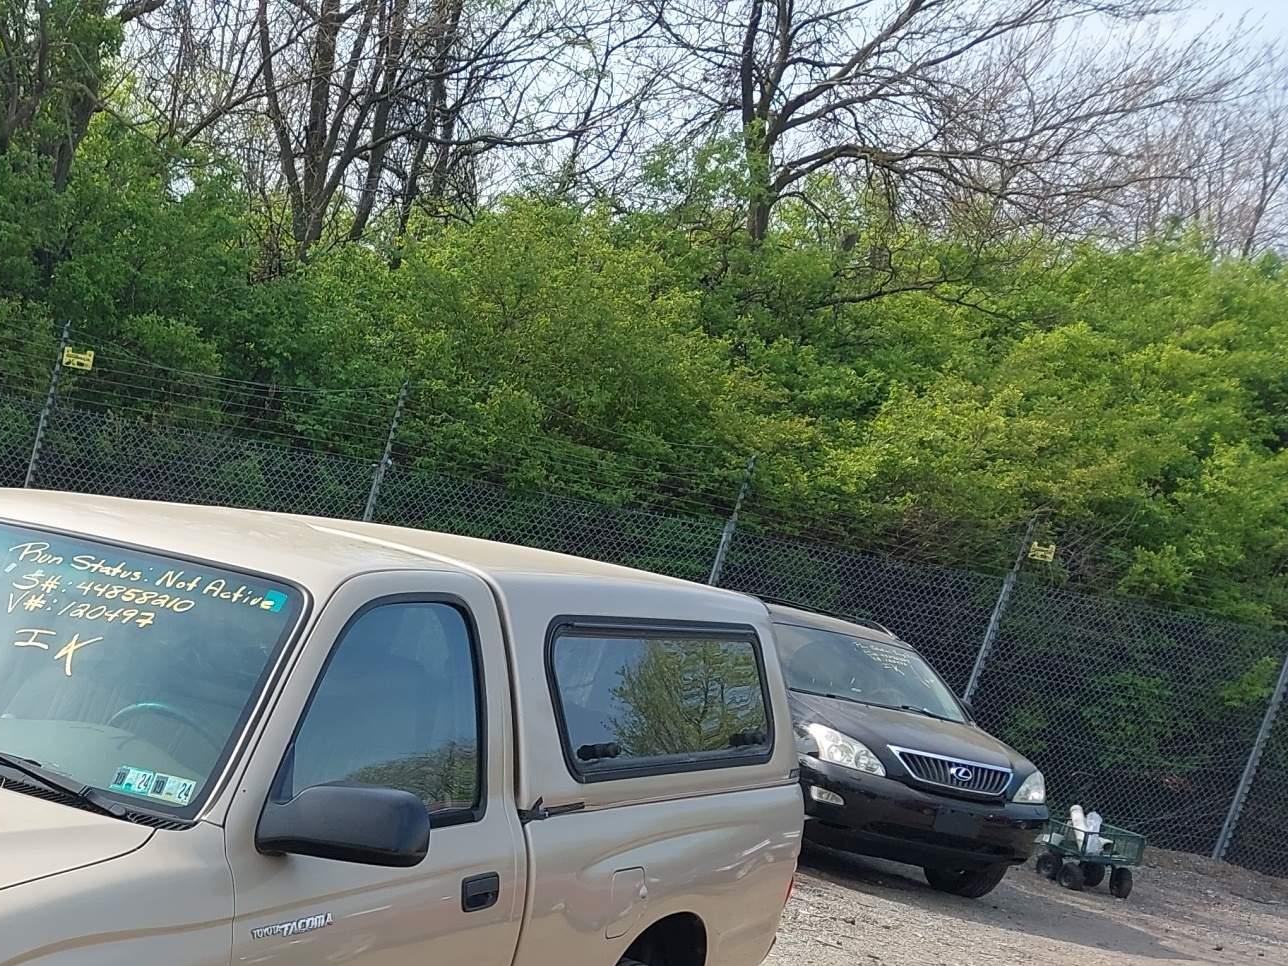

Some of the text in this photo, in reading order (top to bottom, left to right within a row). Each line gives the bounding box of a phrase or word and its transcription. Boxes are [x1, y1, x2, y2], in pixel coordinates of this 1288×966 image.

[9, 542, 275, 610] Run Status: Not Active
[76, 581, 196, 613] 44858210
[58, 601, 157, 628] 120497
[137, 773, 152, 791] 24
[177, 783, 192, 800] 24
[279, 912, 334, 937] TACOMA
